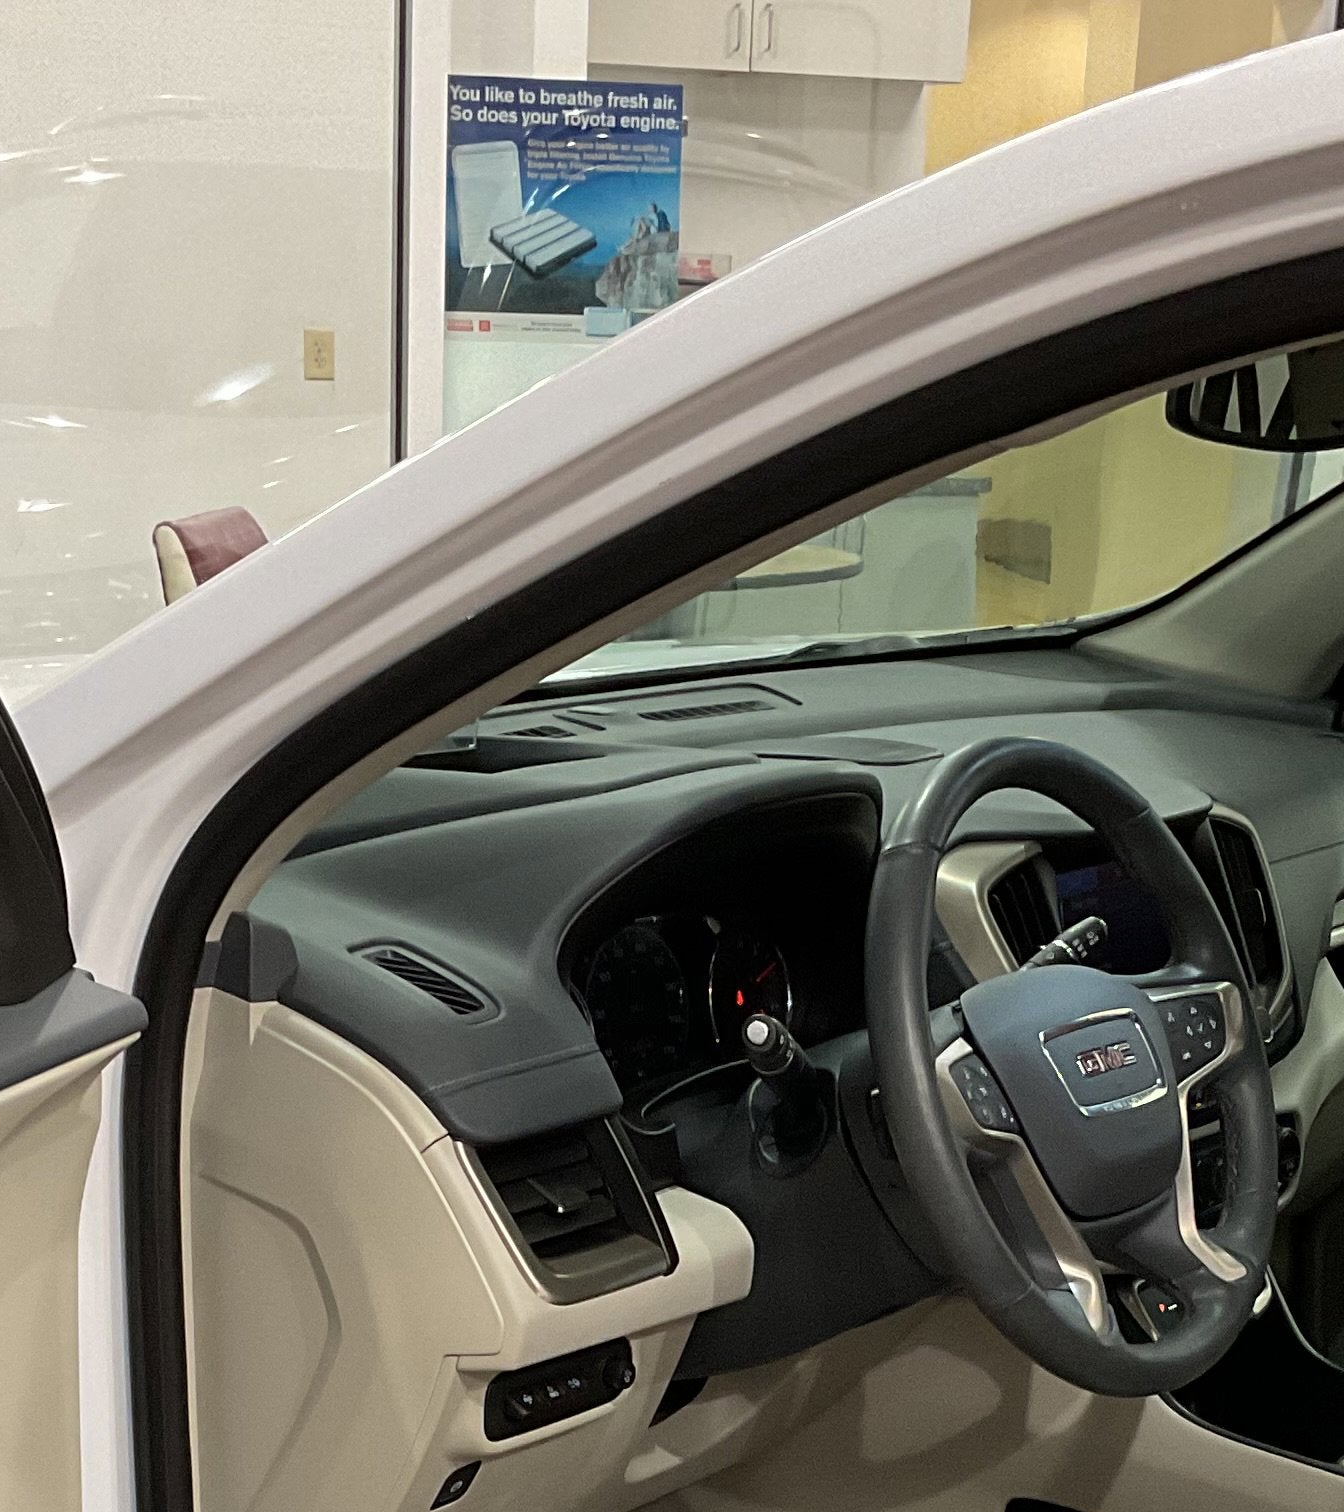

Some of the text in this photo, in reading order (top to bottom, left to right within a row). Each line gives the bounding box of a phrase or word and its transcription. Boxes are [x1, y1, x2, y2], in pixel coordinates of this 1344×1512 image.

[449, 85, 677, 111] You like to breathe fresh air.
[449, 106, 680, 132] So does your Toyota engine.
[1076, 1042, 1137, 1077] GMC
